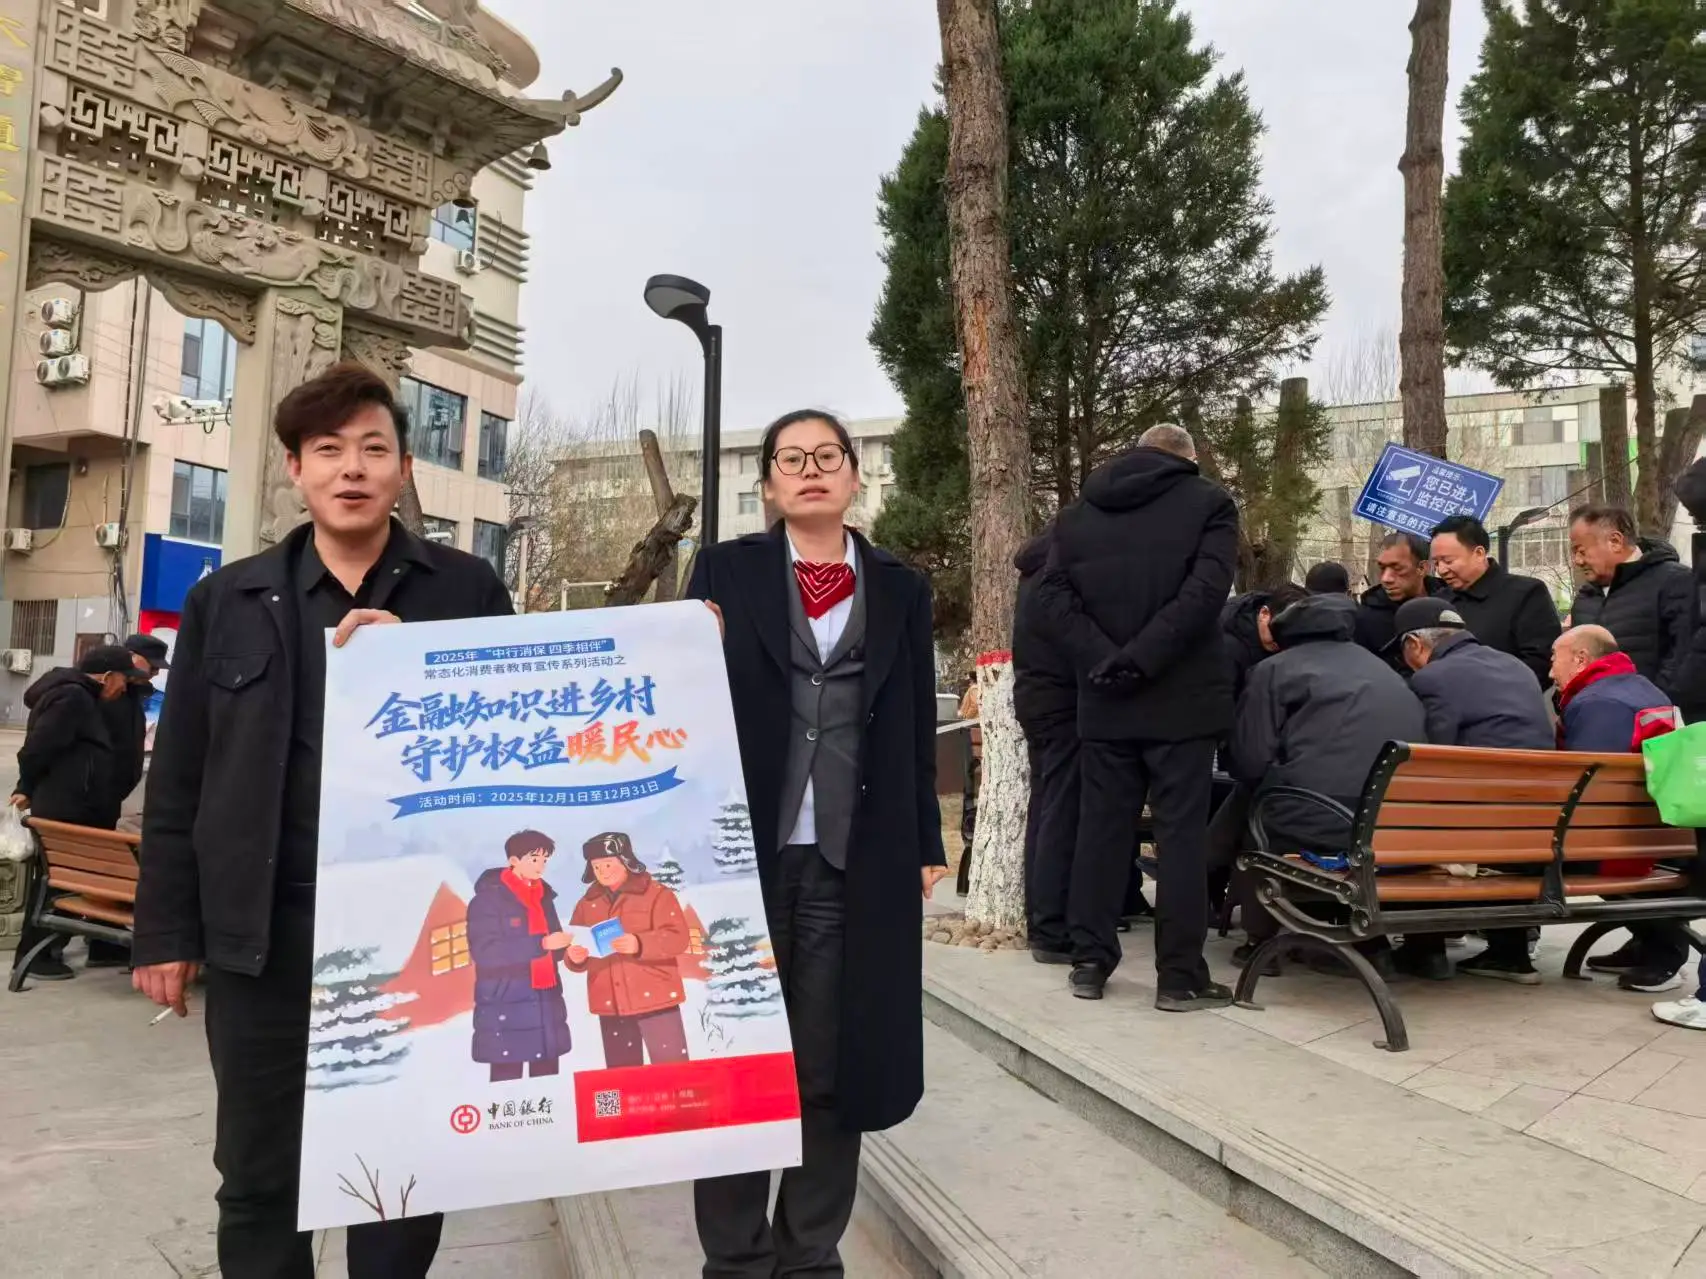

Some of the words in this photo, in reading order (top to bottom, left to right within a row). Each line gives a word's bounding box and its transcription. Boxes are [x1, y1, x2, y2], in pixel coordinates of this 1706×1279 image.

[1423, 475, 1478, 506] 您已进入
[1366, 502, 1436, 533] 请注意您的行
[424, 655, 626, 680] 常态化消费者教育宣传系列活动之
[433, 650, 478, 664] 2025年
[364, 675, 656, 739] 金融知识进乡村
[400, 720, 688, 783] 守护权益暖民心
[488, 1121, 512, 1130] BANK
[513, 1120, 525, 1128] OF
[526, 1116, 554, 1126] CHINA
